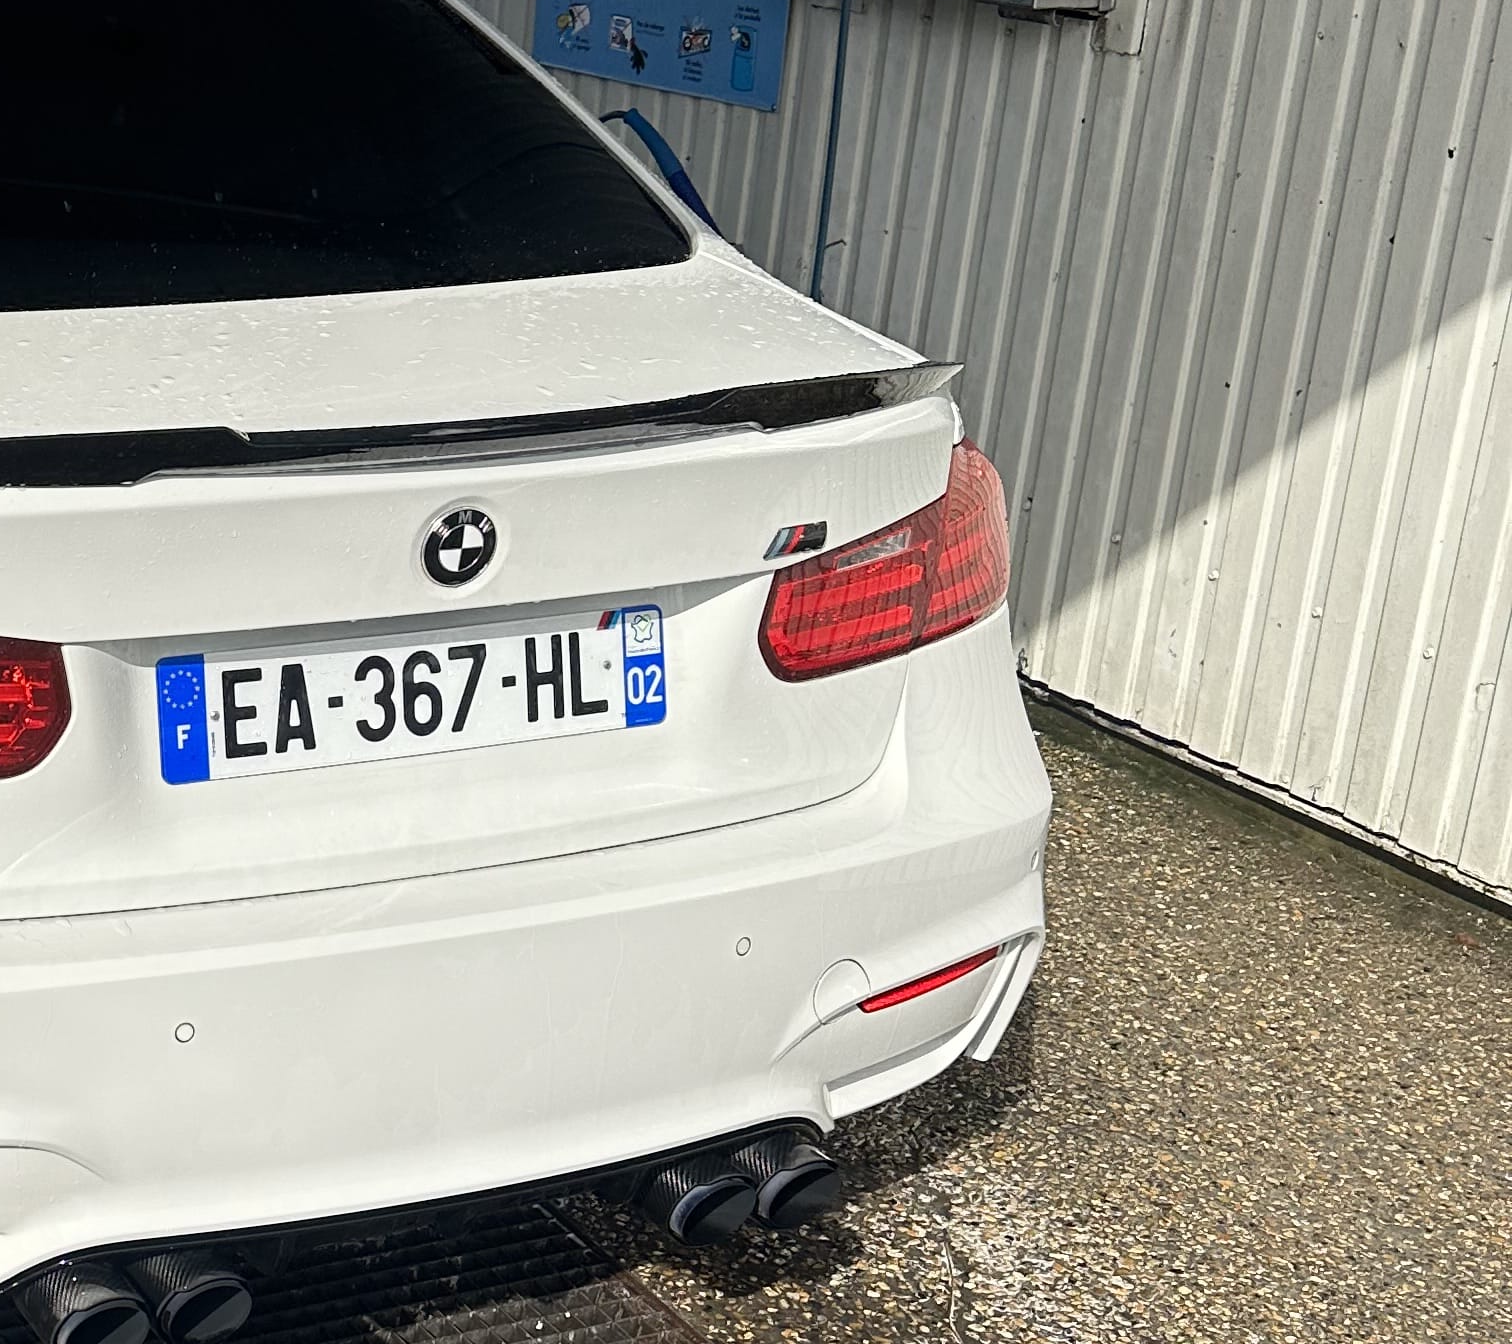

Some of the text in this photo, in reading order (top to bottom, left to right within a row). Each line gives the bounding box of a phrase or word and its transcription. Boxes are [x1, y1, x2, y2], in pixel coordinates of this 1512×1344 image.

[222, 632, 609, 759] EA-367-HL
[626, 664, 663, 705] 02
[176, 724, 191, 749] F
